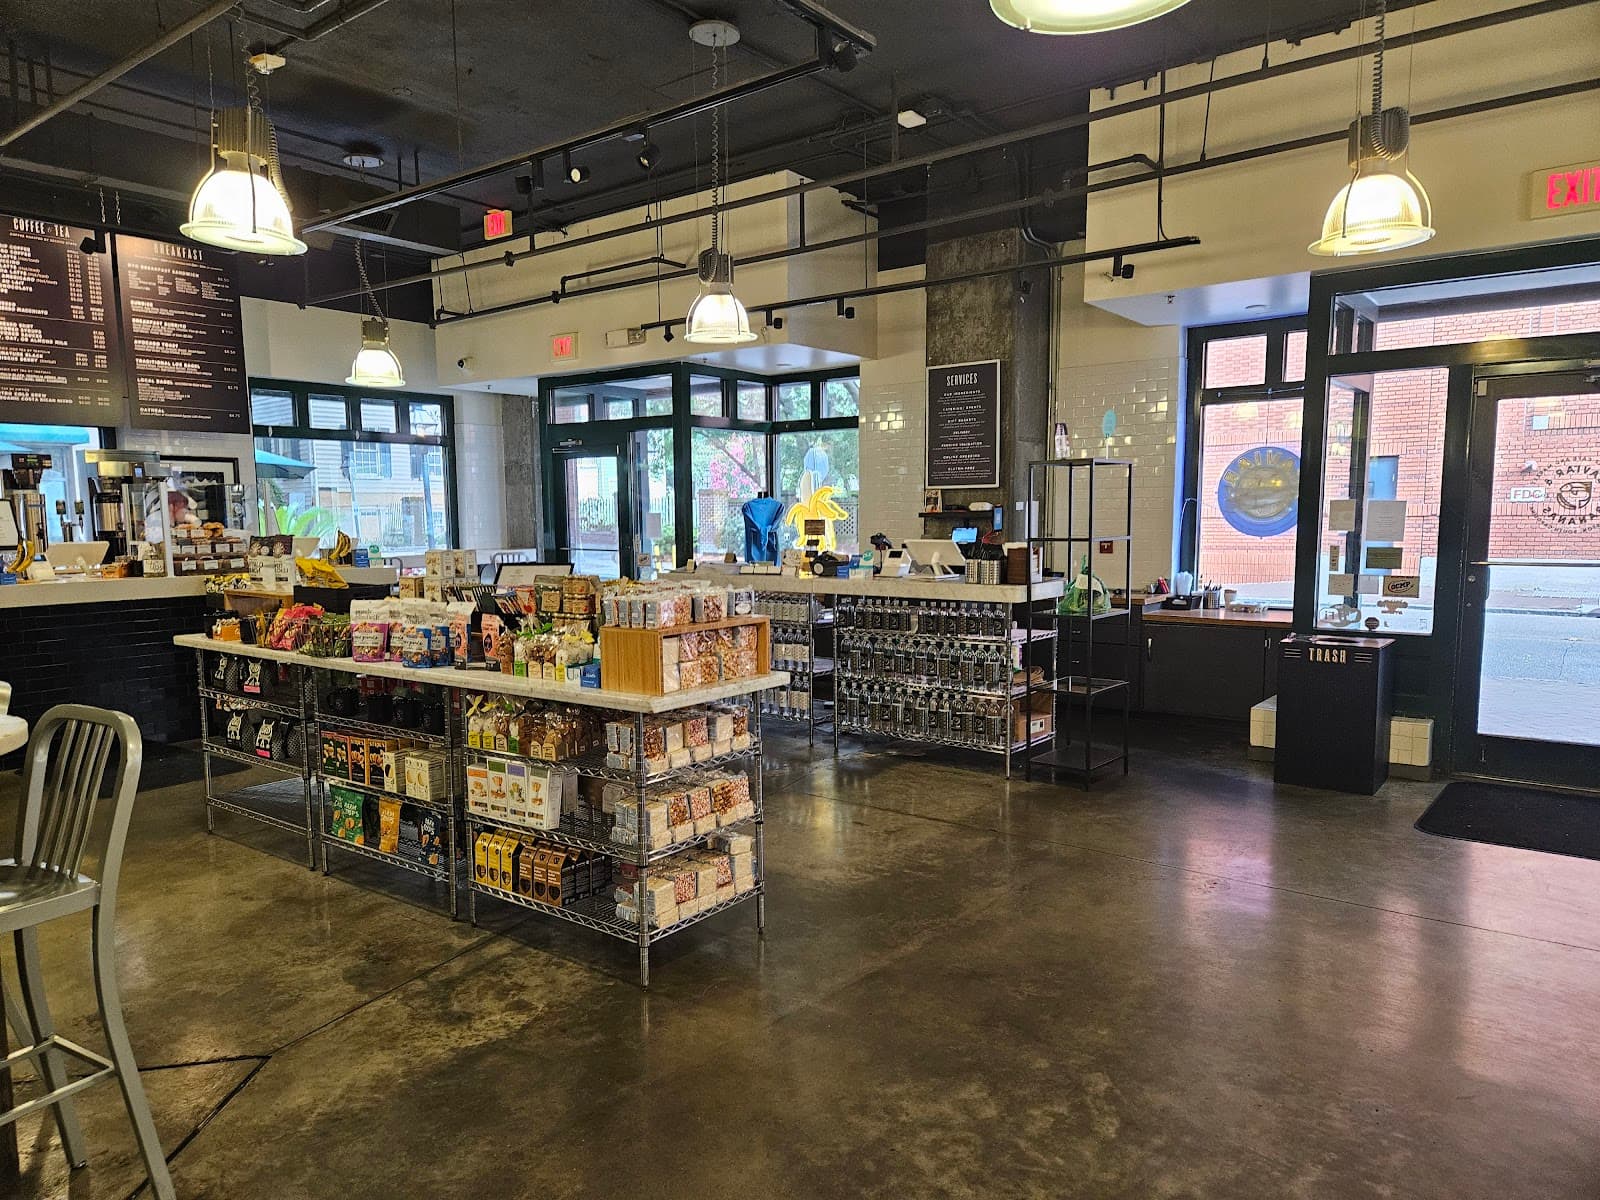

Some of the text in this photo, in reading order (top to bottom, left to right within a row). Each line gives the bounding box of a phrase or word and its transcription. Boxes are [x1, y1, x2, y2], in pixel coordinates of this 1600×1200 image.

[13, 217, 46, 235] COFFEE
[54, 224, 70, 238] TEA
[153, 243, 203, 261] BREAKFAST
[946, 372, 978, 387] SERVICES
[1308, 647, 1347, 665] TRASH
